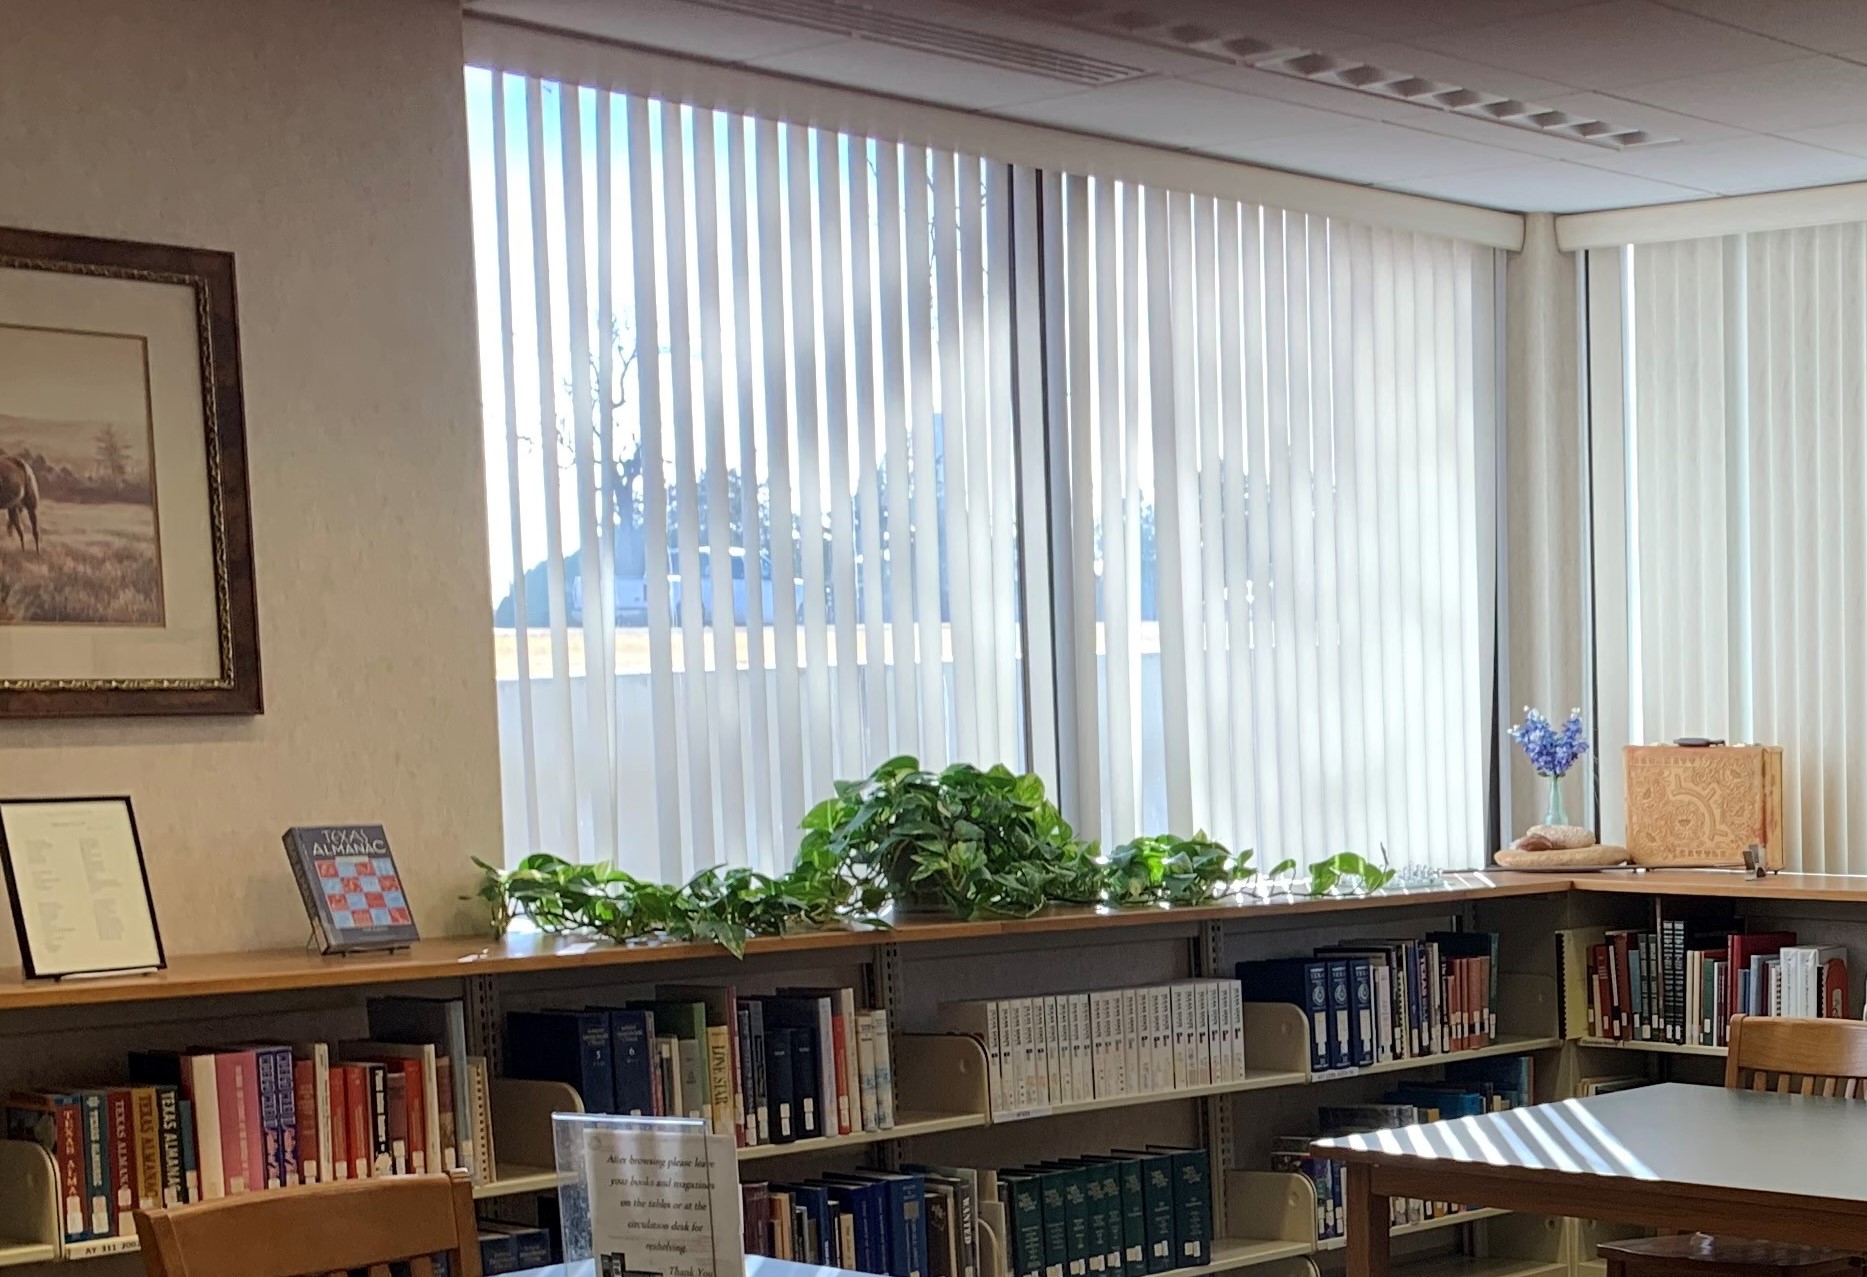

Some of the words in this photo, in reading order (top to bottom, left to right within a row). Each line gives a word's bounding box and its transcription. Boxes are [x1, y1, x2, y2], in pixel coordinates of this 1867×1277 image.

[322, 829, 369, 844] TEXAS
[312, 840, 386, 856] ALMANAC
[711, 1045, 727, 1072] LONE
[713, 1076, 729, 1105] STAR
[115, 1099, 126, 1139] TEXAS
[139, 1094, 154, 1132] TEXAS
[161, 1091, 177, 1130] TEXAS
[142, 1136, 158, 1198] ALMANAC
[607, 1155, 626, 1166] After
[630, 1156, 665, 1168] browsing
[668, 1156, 692, 1168] please
[694, 1157, 715, 1168] leave
[67, 1159, 78, 1196] ALMA
[609, 1179, 628, 1188] your
[630, 1177, 654, 1188] books
[656, 1178, 671, 1188] and
[673, 1180, 715, 1191] magazines
[621, 1200, 631, 1208] on
[633, 1197, 645, 1208] the
[649, 1198, 671, 1209] tables
[673, 1202, 682, 1210] or
[684, 1202, 692, 1210] at
[694, 1201, 707, 1211] the
[628, 1220, 669, 1231] circulation
[671, 1221, 689, 1232] desk
[691, 1223, 703, 1232] for
[670, 1266, 693, 1277] Thank
[698, 1266, 713, 1277] You
